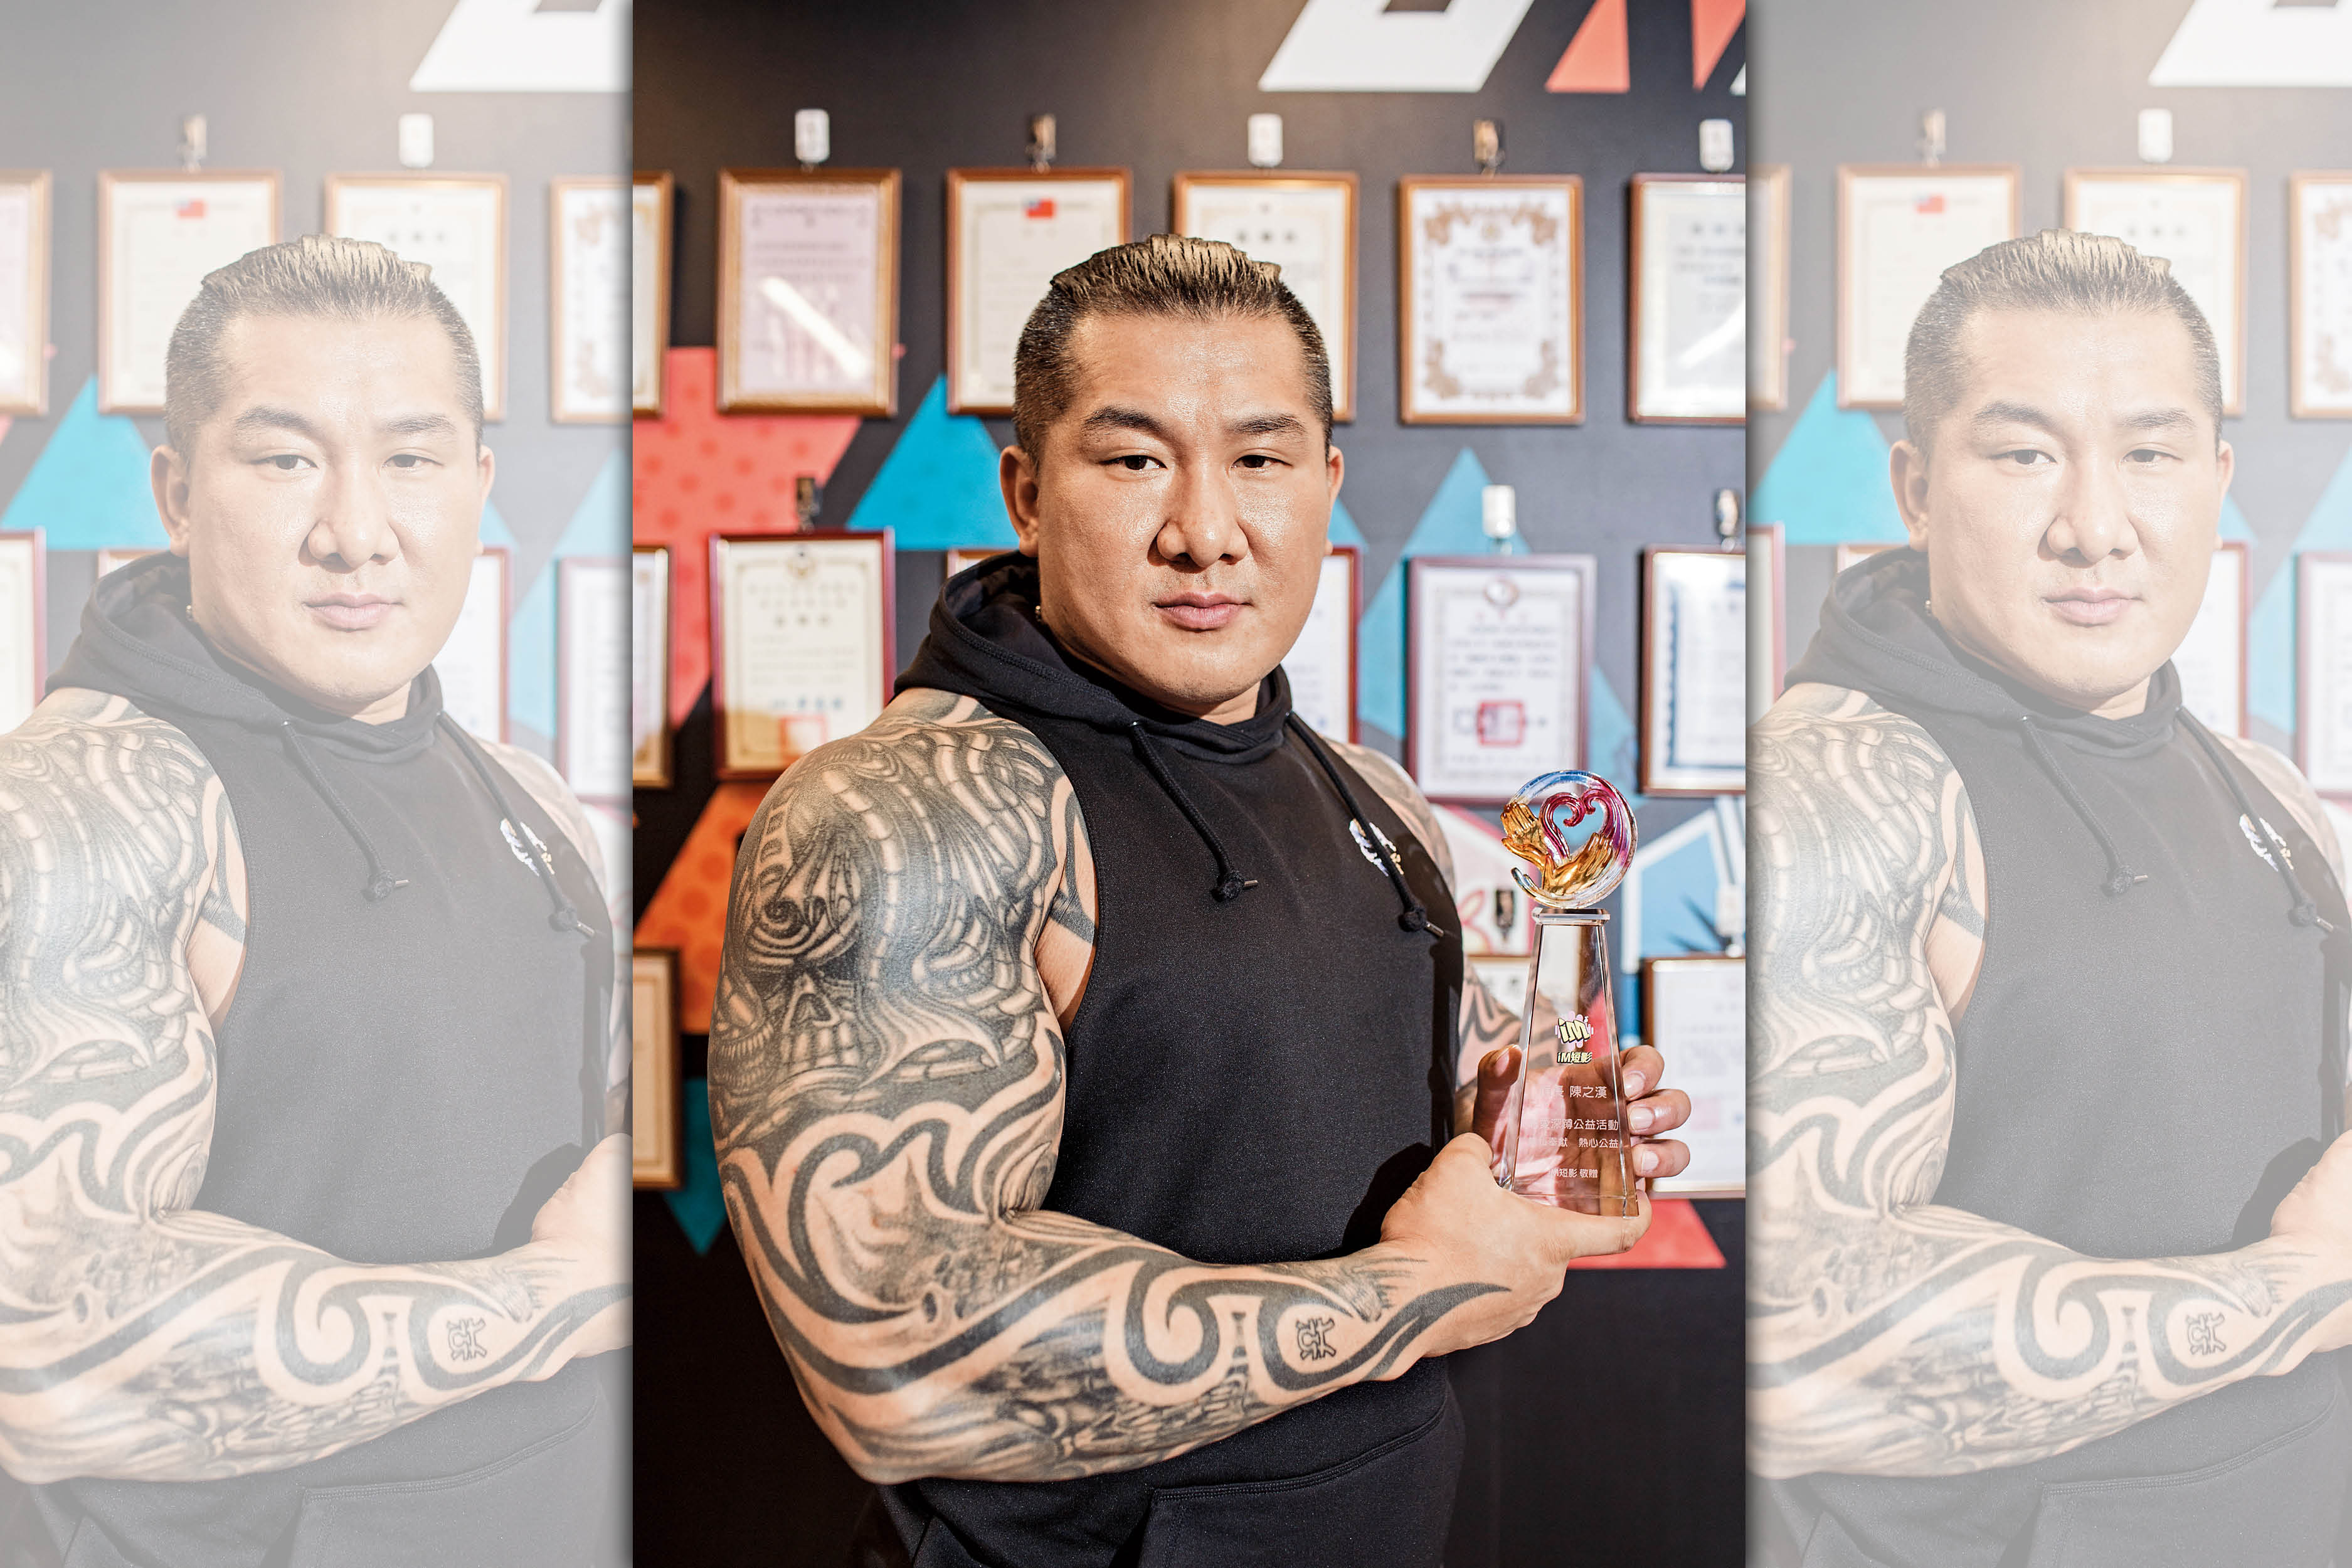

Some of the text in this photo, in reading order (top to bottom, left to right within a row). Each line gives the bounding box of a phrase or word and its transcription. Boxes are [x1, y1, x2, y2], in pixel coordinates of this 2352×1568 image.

[1557, 1052, 1592, 1064] iM短影
[1569, 1085, 1608, 1098] 陳之漢
[1529, 1118, 1619, 1131] 愛深蹲公益活動
[1578, 1137, 1619, 1148] 熱心公益
[1579, 1168, 1598, 1179] 敬贈
